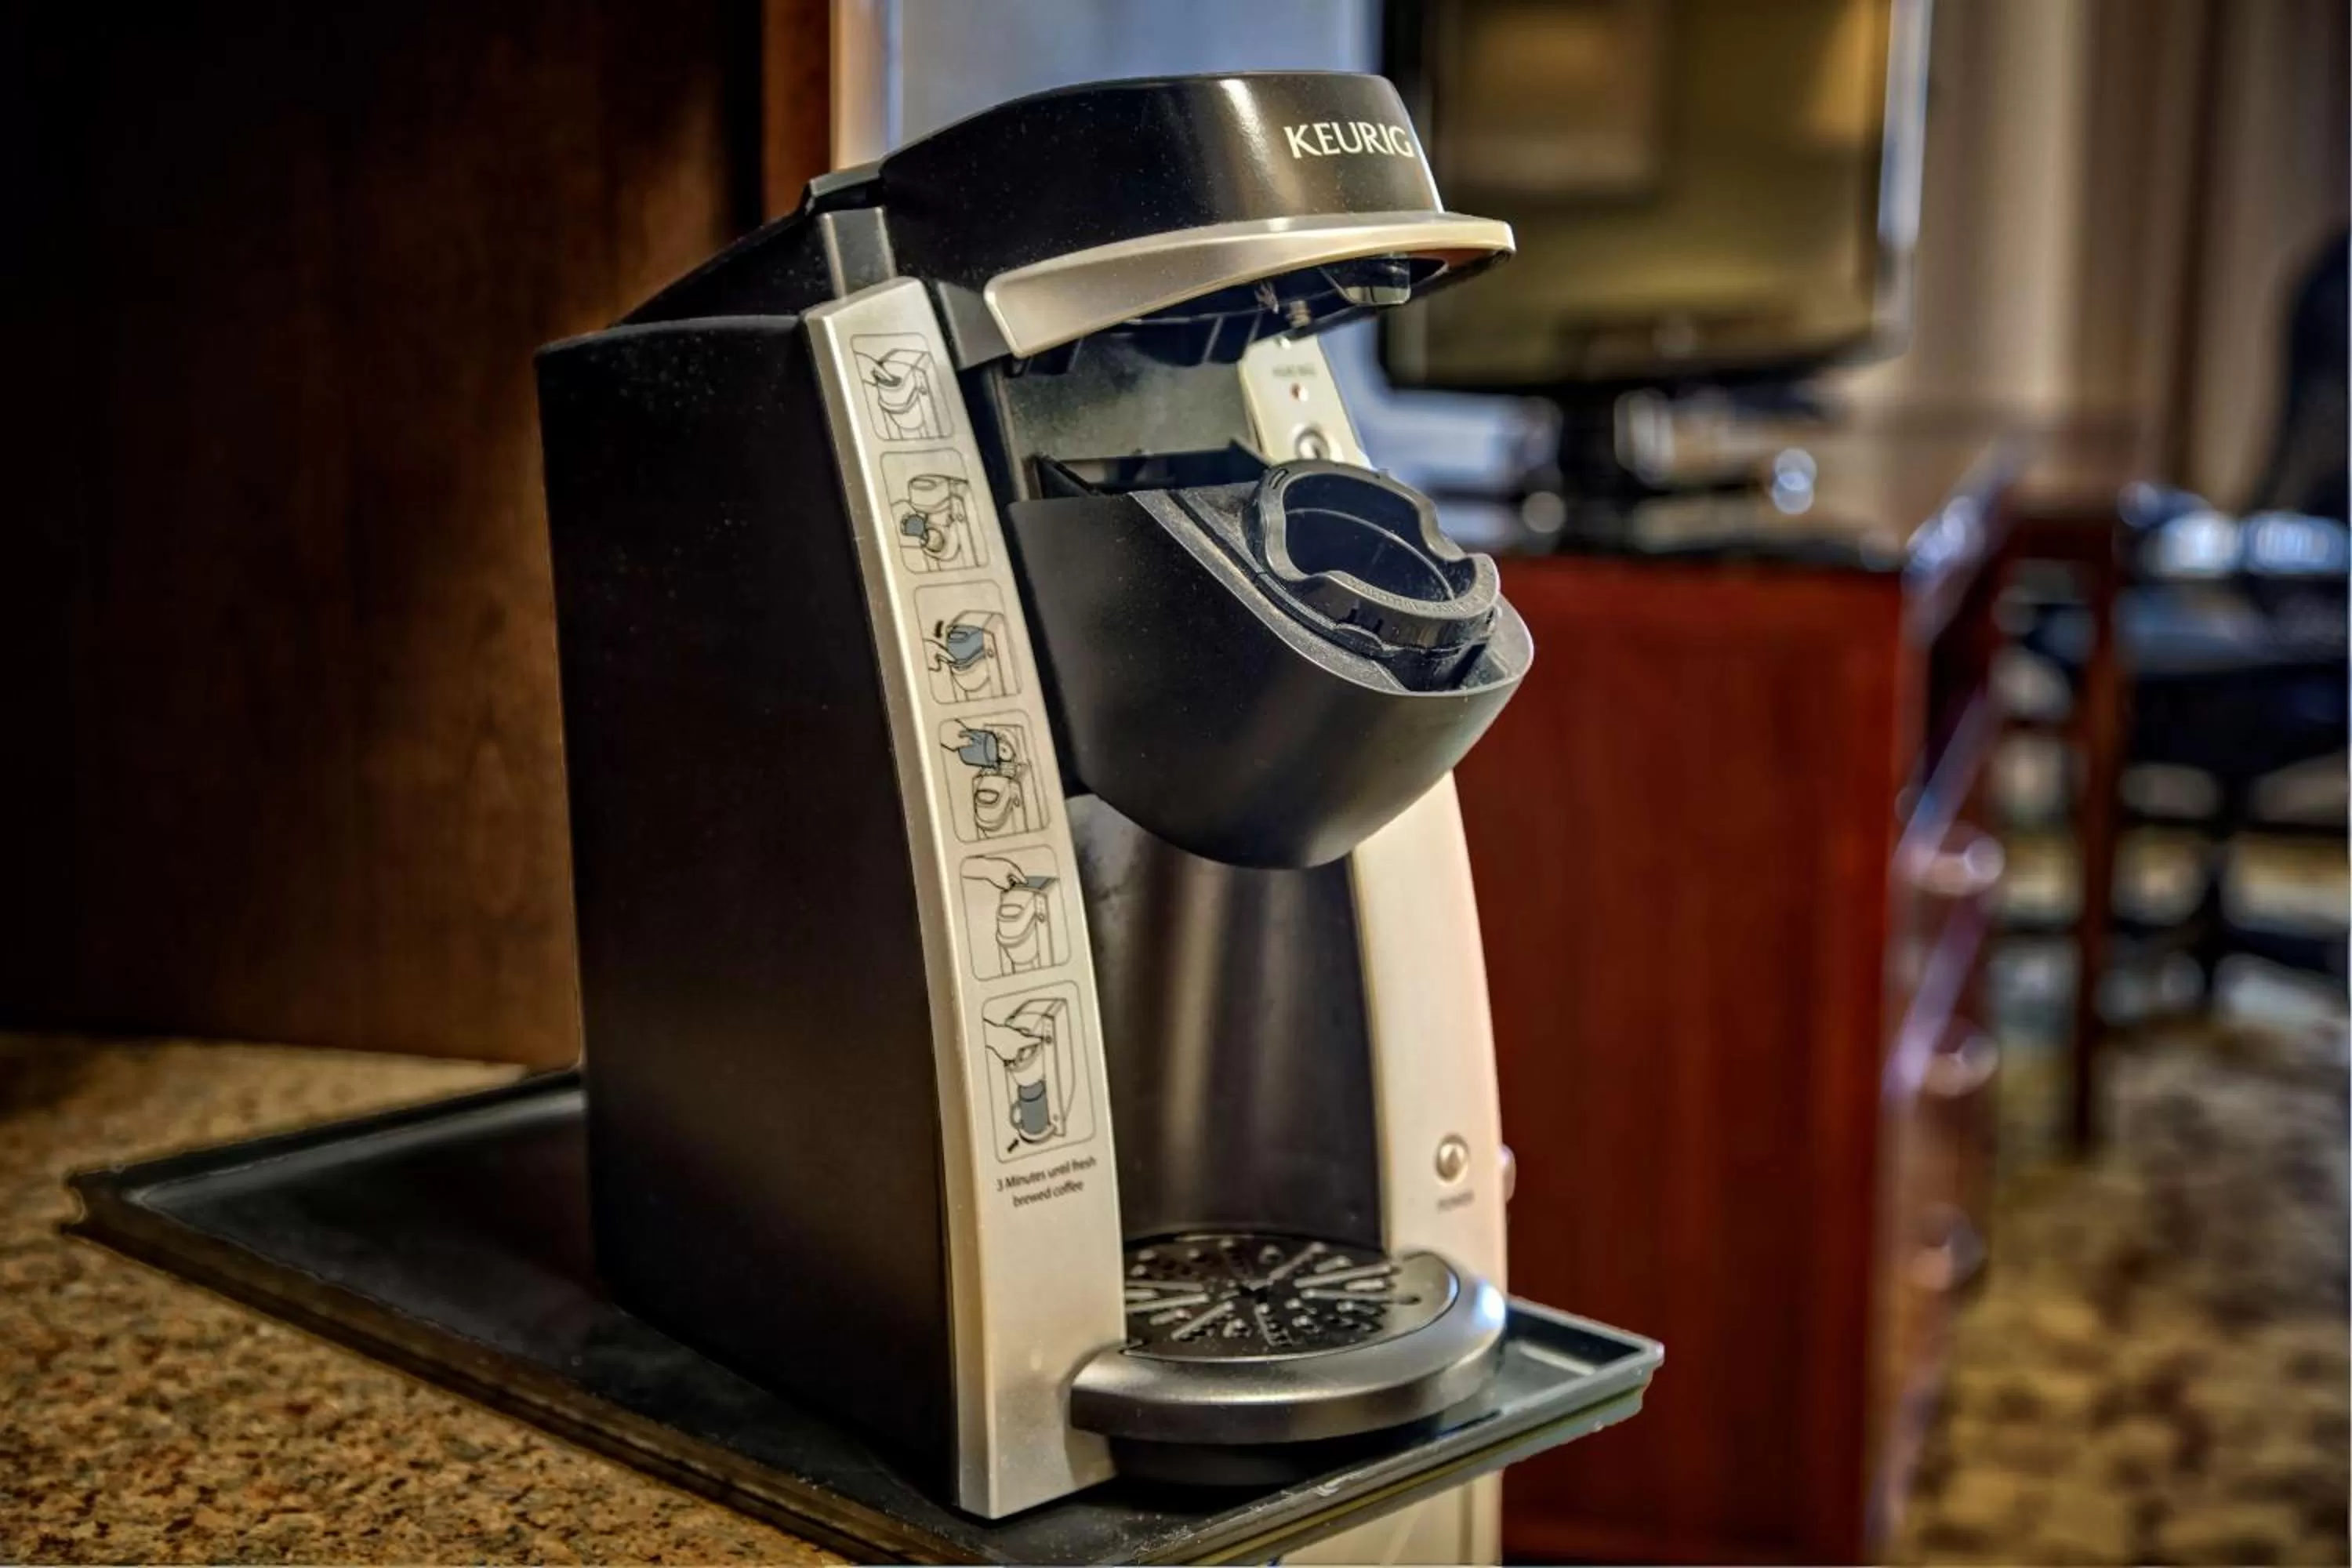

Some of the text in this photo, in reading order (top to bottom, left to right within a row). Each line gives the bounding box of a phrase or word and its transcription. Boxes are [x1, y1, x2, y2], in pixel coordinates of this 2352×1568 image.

[1283, 122, 1414, 159] KEURIG
[996, 1155, 1097, 1192] 3 Minutes until fresh
[1012, 1180, 1084, 1208] brewed coffee
